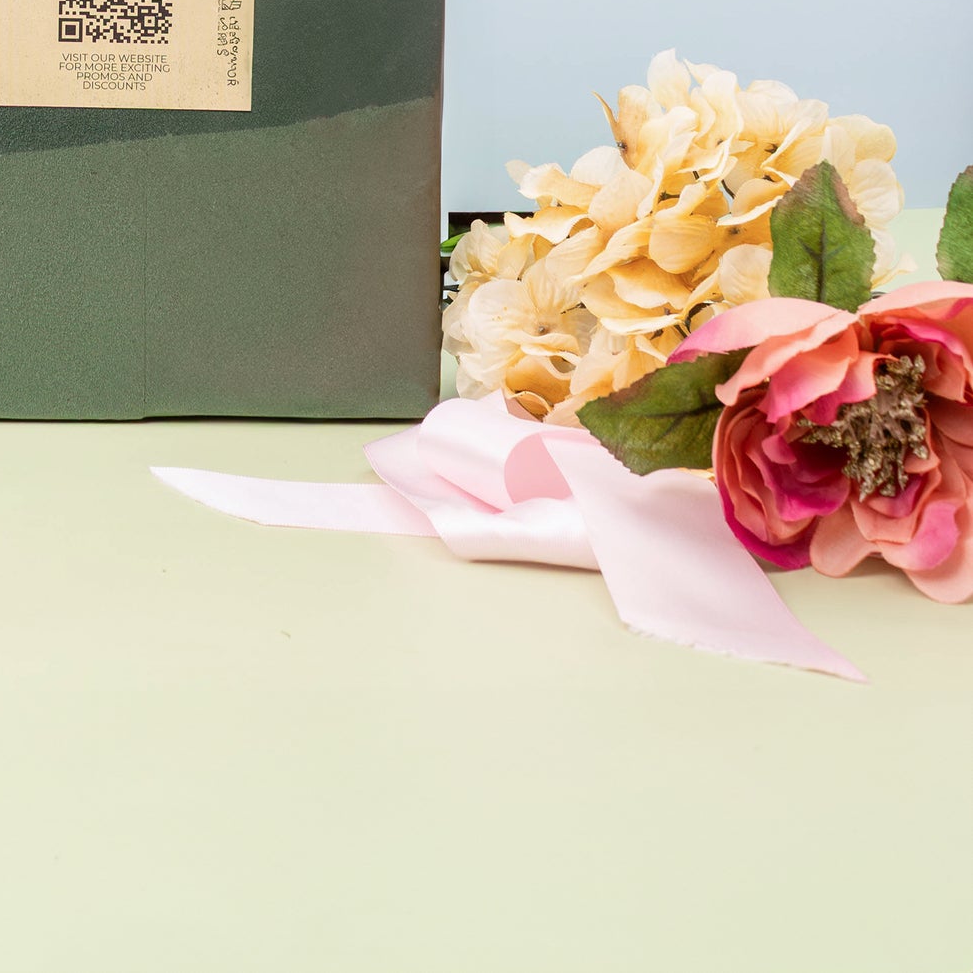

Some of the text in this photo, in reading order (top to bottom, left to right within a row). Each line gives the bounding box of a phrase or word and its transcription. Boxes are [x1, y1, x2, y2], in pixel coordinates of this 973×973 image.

[61, 53, 168, 63] VISIT OUR WEBSITE
[59, 62, 171, 73] FOR MORE EXCITING
[76, 72, 153, 82] PROMOS AND
[82, 81, 146, 90] DISCOUNTS
